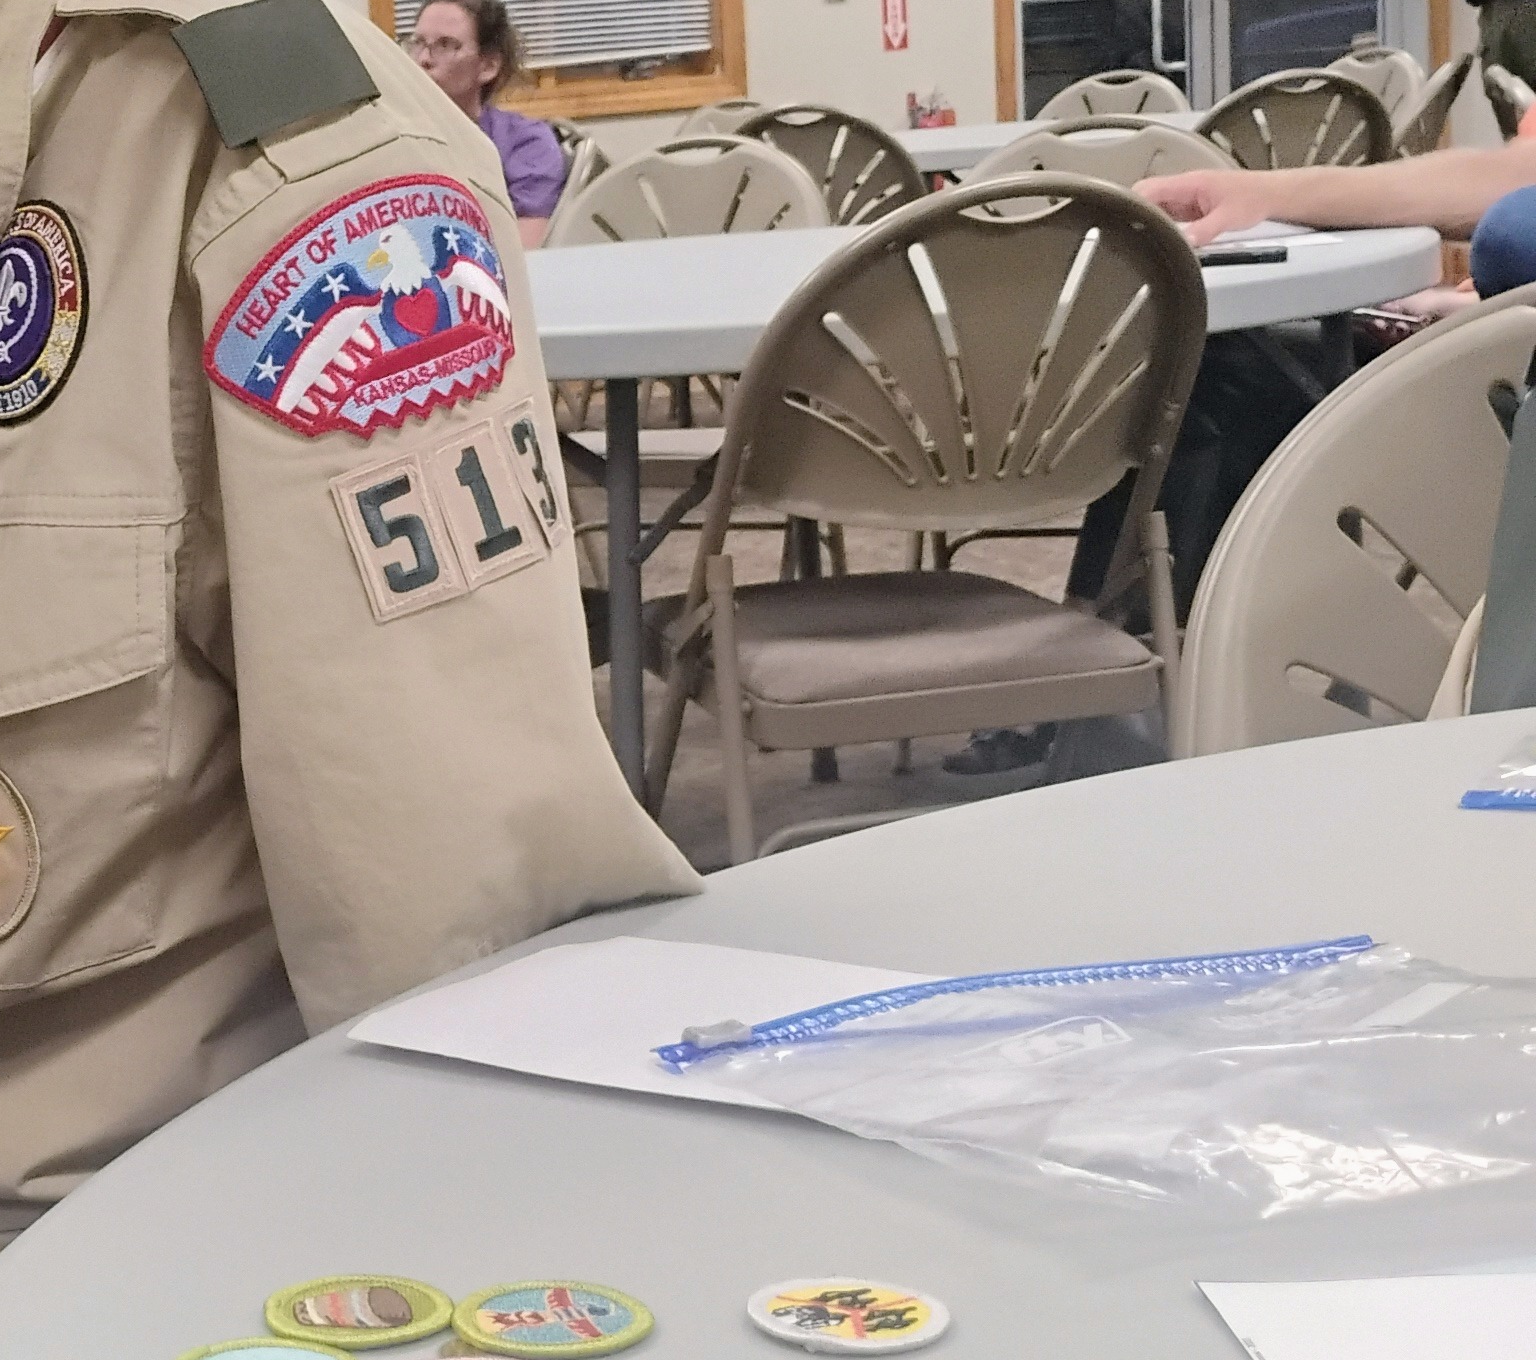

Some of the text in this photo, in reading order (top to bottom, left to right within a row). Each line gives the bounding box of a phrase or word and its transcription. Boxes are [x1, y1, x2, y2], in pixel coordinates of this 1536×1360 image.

[38, 215, 74, 297] AMERICA
[236, 256, 306, 339] HEART
[306, 226, 337, 264] OF
[343, 192, 440, 244] AMERICA
[4, 379, 38, 412] 1910
[355, 419, 558, 594] 513
